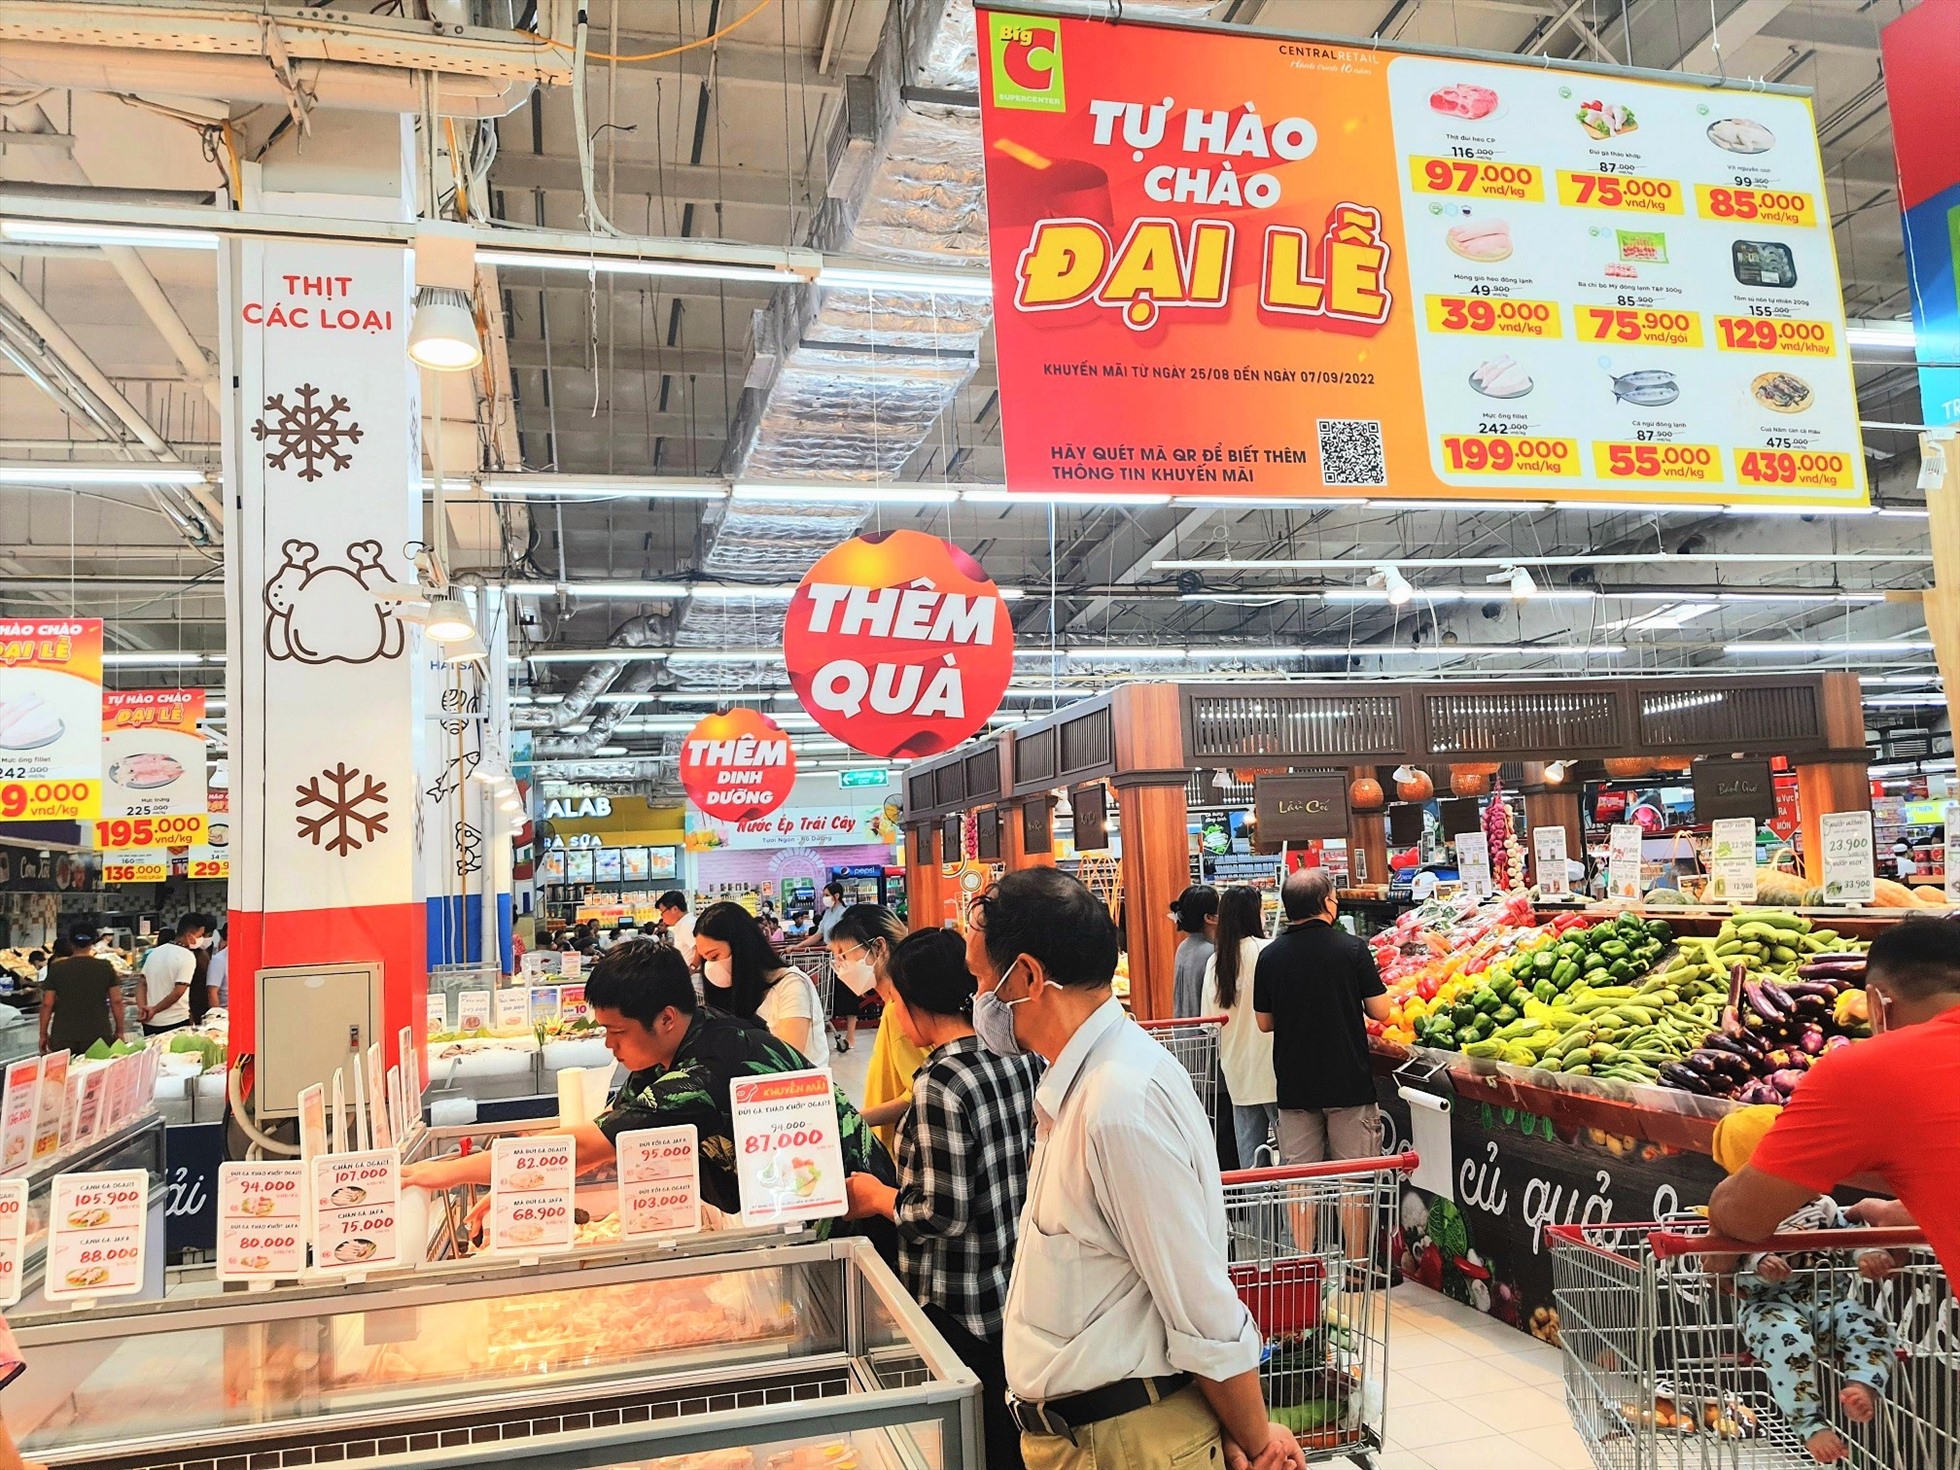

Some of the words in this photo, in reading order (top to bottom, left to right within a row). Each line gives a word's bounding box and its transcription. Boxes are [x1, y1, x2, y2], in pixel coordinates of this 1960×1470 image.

[1000, 26, 1033, 46] Big
[1003, 27, 1057, 91] C
[999, 93, 1060, 105] SUPERCENTER
[1088, 97, 1174, 162] TỰ
[1182, 100, 1318, 160] HÀO
[1451, 146, 1494, 159] 116.000
[1599, 162, 1635, 173] 87.000
[1425, 160, 1532, 192] 97.000
[1143, 160, 1281, 209] CHÀO
[1482, 185, 1525, 198] vnd/kg
[1571, 174, 1672, 207] 75.000
[1625, 199, 1665, 211] vnd/kg
[1709, 188, 1805, 219] 85.000
[1760, 210, 1799, 224] vnd/kg
[1014, 217, 1236, 331] ĐẠI
[1260, 202, 1392, 324] LỄ
[282, 274, 353, 302] THỊT
[1471, 284, 1510, 296] 49.900
[1617, 295, 1653, 306] 85.900
[242, 302, 309, 330] CÁC
[319, 308, 393, 335] LOẠI
[1440, 298, 1550, 331] 39.000
[1749, 305, 1789, 317] 155.000
[1498, 322, 1543, 335] vnd/kg
[1589, 309, 1689, 341] 75.900
[1644, 332, 1688, 344] vnd/gói
[1719, 318, 1825, 350] 129.000
[1780, 342, 1830, 355] vnd/khay
[1043, 359, 1098, 377] KHUYẾN
[1102, 363, 1128, 377] MÃI
[1131, 364, 1149, 379] TỪ
[1152, 364, 1186, 380] NGÀY
[1190, 368, 1229, 381] 25/08
[1233, 363, 1260, 382] ĐẾN
[1263, 367, 1297, 383] NGÀY
[1300, 370, 1375, 385] 07/09/2022
[1479, 423, 1528, 434] 242.000
[1766, 437, 1809, 448] 475.000
[1051, 443, 1086, 461] HÃY
[1092, 443, 1134, 462] QUÉT
[1140, 444, 1167, 462] MÃ
[1173, 449, 1197, 463] QR
[1202, 442, 1224, 463] ĐỂ
[1228, 442, 1258, 464] BIẾT
[1263, 446, 1307, 464] THÊM
[1444, 437, 1568, 471] 199.000
[1609, 445, 1711, 477] 55.000
[1052, 462, 1115, 481] THÔNG
[1120, 467, 1146, 481] TIN
[1151, 463, 1216, 483] KHUYẾN
[1222, 465, 1254, 483] MÃI
[1516, 460, 1561, 473] vnd/kg
[1663, 467, 1704, 479] vnd/kg
[1741, 451, 1843, 483] 439.000
[1799, 475, 1837, 487] vnd/kg
[807, 576, 997, 646] THÊM
[38, 622, 83, 636] CHÀO
[0, 640, 35, 664] ẠI
[38, 635, 72, 661] LỄ
[811, 652, 966, 719] QUÀ
[126, 693, 153, 704] HÀO
[156, 691, 192, 703] CHÀO
[116, 708, 154, 728] ĐẠI
[157, 703, 185, 724] LỄ
[687, 733, 787, 767] THÊM
[717, 770, 763, 785] DINH
[706, 788, 774, 806] DƯỠNG
[31, 803, 78, 817] vnd/kg
[543, 796, 612, 818] ALAB
[96, 817, 200, 847] 195.000
[800, 815, 827, 831] Trái
[831, 815, 856, 833] Cây
[155, 834, 193, 844] vnd/kg
[1830, 838, 1868, 851] 23.900
[105, 866, 161, 880] 136.000
[854, 866, 875, 875] pepsi
[1844, 880, 1870, 889] 33.900
[575, 1005, 587, 1015] 10
[771, 1121, 806, 1133] 94.000
[745, 1129, 823, 1154] 87.000
[641, 1145, 691, 1161] 95.000
[517, 1155, 568, 1170] 82.000
[335, 1168, 388, 1184] 107.000
[240, 1181, 295, 1193] 94.000
[75, 1191, 139, 1207] 105.900
[633, 1194, 688, 1210] 103.000
[1460, 1141, 1507, 1215] củ
[1522, 1171, 1623, 1255] quả
[513, 1207, 566, 1221] 68.900
[341, 1217, 394, 1234] 75.000
[240, 1237, 295, 1249] 80.000
[80, 1247, 138, 1264] 88.000
